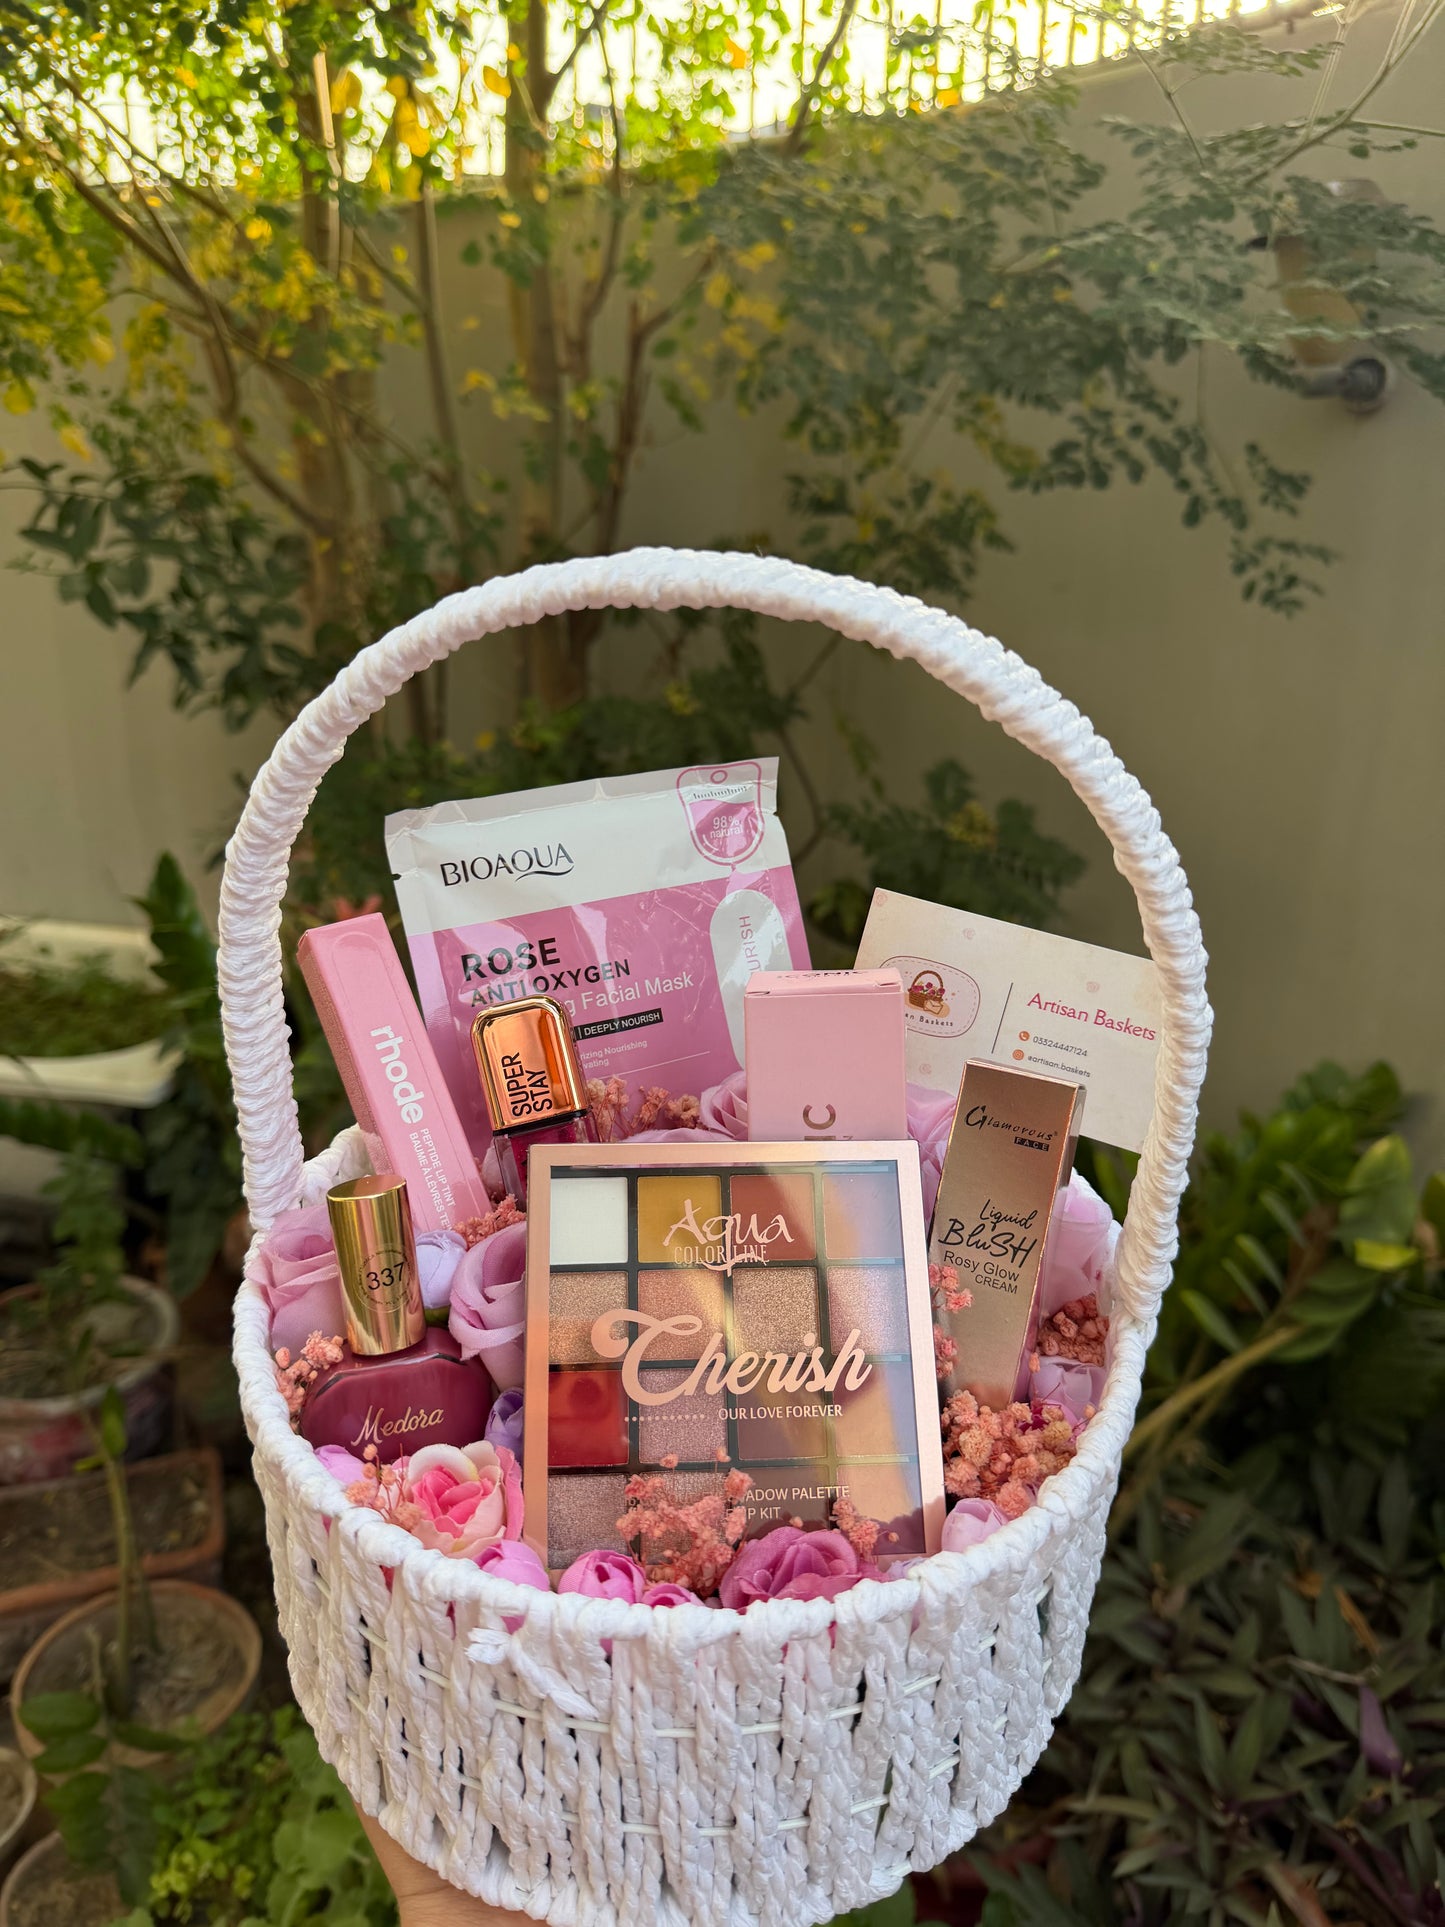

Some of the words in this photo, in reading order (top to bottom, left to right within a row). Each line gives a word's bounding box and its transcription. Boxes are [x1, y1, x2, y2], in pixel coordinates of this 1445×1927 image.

[710, 824, 743, 839] natural
[713, 815, 739, 829] 98%
[440, 843, 574, 886] BIOAQUA
[461, 937, 560, 981] ROSE
[739, 916, 760, 971] URISH
[471, 980, 526, 1007] ANTI
[532, 958, 631, 993] OXYGEN
[581, 982, 640, 1010] Facial
[645, 971, 694, 996] Mask
[584, 1020, 620, 1036] DEEPLY
[621, 1012, 660, 1028] NOURISH
[1027, 993, 1089, 1022] Artisan
[1093, 1009, 1156, 1041] Baskets
[580, 1049, 602, 1061] rizing
[604, 1040, 648, 1055] Nourishing
[582, 1057, 609, 1070] vating
[370, 1025, 424, 1124] rhode
[501, 1052, 532, 1117] SUPER
[525, 1070, 553, 1112] STAY
[409, 1132, 428, 1166] BAUME
[1015, 1137, 1049, 1151] FACE
[420, 1128, 441, 1169] PEPTIDE
[435, 1169, 447, 1185] LIP
[441, 1184, 456, 1207] TINT
[979, 1199, 1038, 1232] Liquid
[663, 1199, 795, 1277] Aqua
[674, 1246, 727, 1265] COLOR
[733, 1244, 770, 1264] LINE
[366, 1261, 405, 1291] 337
[944, 1251, 980, 1273] Rosy
[984, 1262, 1019, 1282] Glow
[975, 1274, 1018, 1294] CREAM
[591, 1309, 872, 1406] Cherish
[351, 1405, 444, 1446] Medora
[718, 1407, 747, 1420] OUR
[750, 1406, 783, 1419] LOVE
[786, 1404, 843, 1418] FOREVER
[792, 1485, 850, 1500] PALETTE
[760, 1507, 781, 1519] KIT
